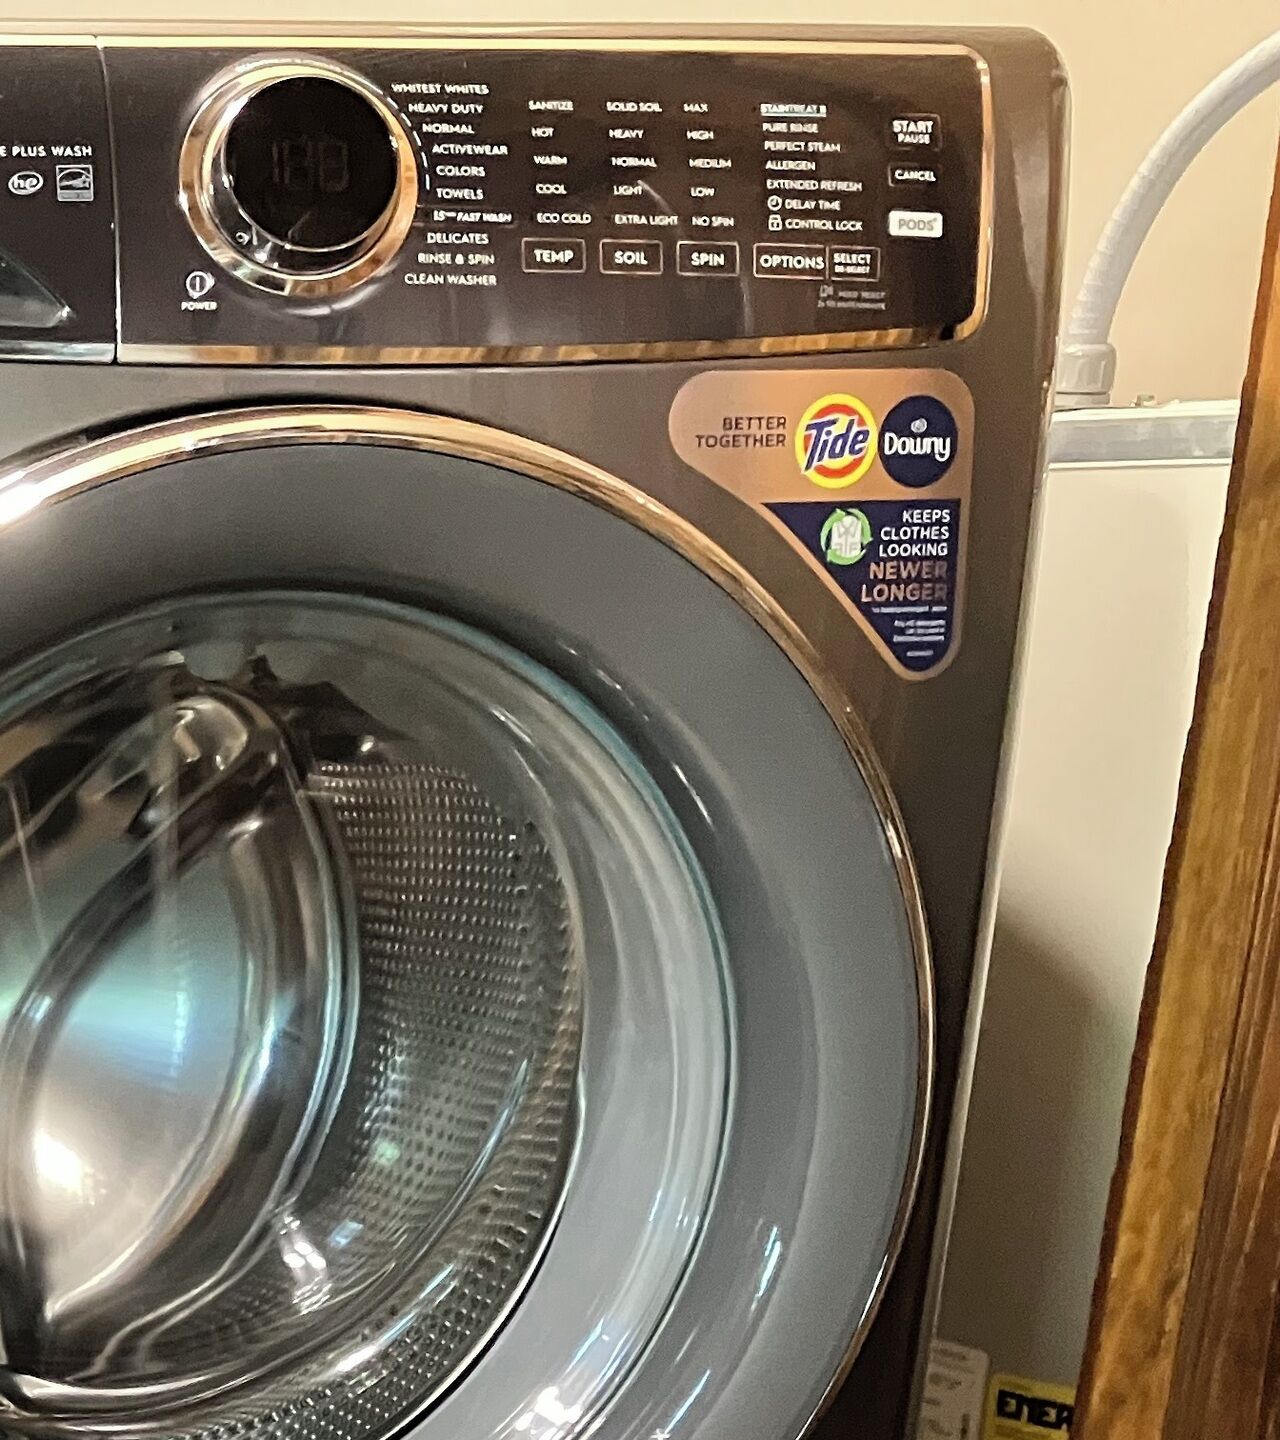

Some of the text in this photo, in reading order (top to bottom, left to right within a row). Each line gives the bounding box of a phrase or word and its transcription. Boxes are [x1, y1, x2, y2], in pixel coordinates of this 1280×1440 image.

[391, 83, 490, 95] WHITEST WHITES
[408, 102, 484, 114] HEAVY DUTY
[528, 101, 574, 111] SANITIZE
[606, 102, 662, 112] SOLID SOIL
[684, 103, 708, 113] MAX
[422, 123, 474, 134] NORMAL
[762, 122, 788, 132] PURE
[893, 120, 934, 133] START
[531, 128, 554, 138] HOT
[608, 129, 644, 139] HEAVY
[686, 130, 714, 140] HIGH
[898, 133, 930, 144] PAUSE
[11, 145, 46, 158] PLUS
[50, 146, 92, 158] WASH
[432, 144, 508, 156] ACTIVEWEAR
[764, 141, 840, 152] PERFECT STEAM
[534, 156, 568, 166] WARM
[612, 157, 658, 168] NORMAL
[689, 158, 732, 169] MEDIUM
[766, 160, 816, 172] ALLERGEN
[436, 166, 486, 177] COLORS
[894, 170, 936, 182] CANCEL
[536, 184, 567, 194] COOL
[614, 185, 642, 196] LIGHT
[690, 186, 715, 197] LOW
[766, 179, 862, 192] EXTENDED REFRESH
[436, 188, 484, 200] TOWELS
[785, 200, 841, 211] DELAY TIME
[456, 212, 481, 222] FAST
[482, 212, 512, 223] WASH
[536, 213, 592, 224] ECO COLD
[614, 214, 679, 226] EXTRA LIGHT
[692, 216, 734, 227] NO SPIN
[785, 220, 863, 232] CONTROL LOCK
[426, 232, 489, 245] DELICATES
[418, 252, 494, 265] RINSE & SPIN
[534, 250, 574, 264] TEMP
[614, 251, 648, 265] SOIL
[690, 252, 725, 267] SPIN
[760, 254, 824, 270] OPTIONS
[834, 252, 871, 264] SELECT
[404, 274, 497, 286] CLEAN WASHER
[181, 301, 217, 311] POWER
[722, 416, 787, 430] BETTER
[695, 434, 786, 448] TOGETHER
[803, 415, 870, 473] Tide
[884, 432, 951, 462] Downy
[902, 510, 951, 524] KEEPS
[880, 526, 950, 541] CLOTHES
[878, 543, 948, 558] LOOKING
[869, 561, 948, 580] NEWER
[860, 584, 948, 602] LONGER
